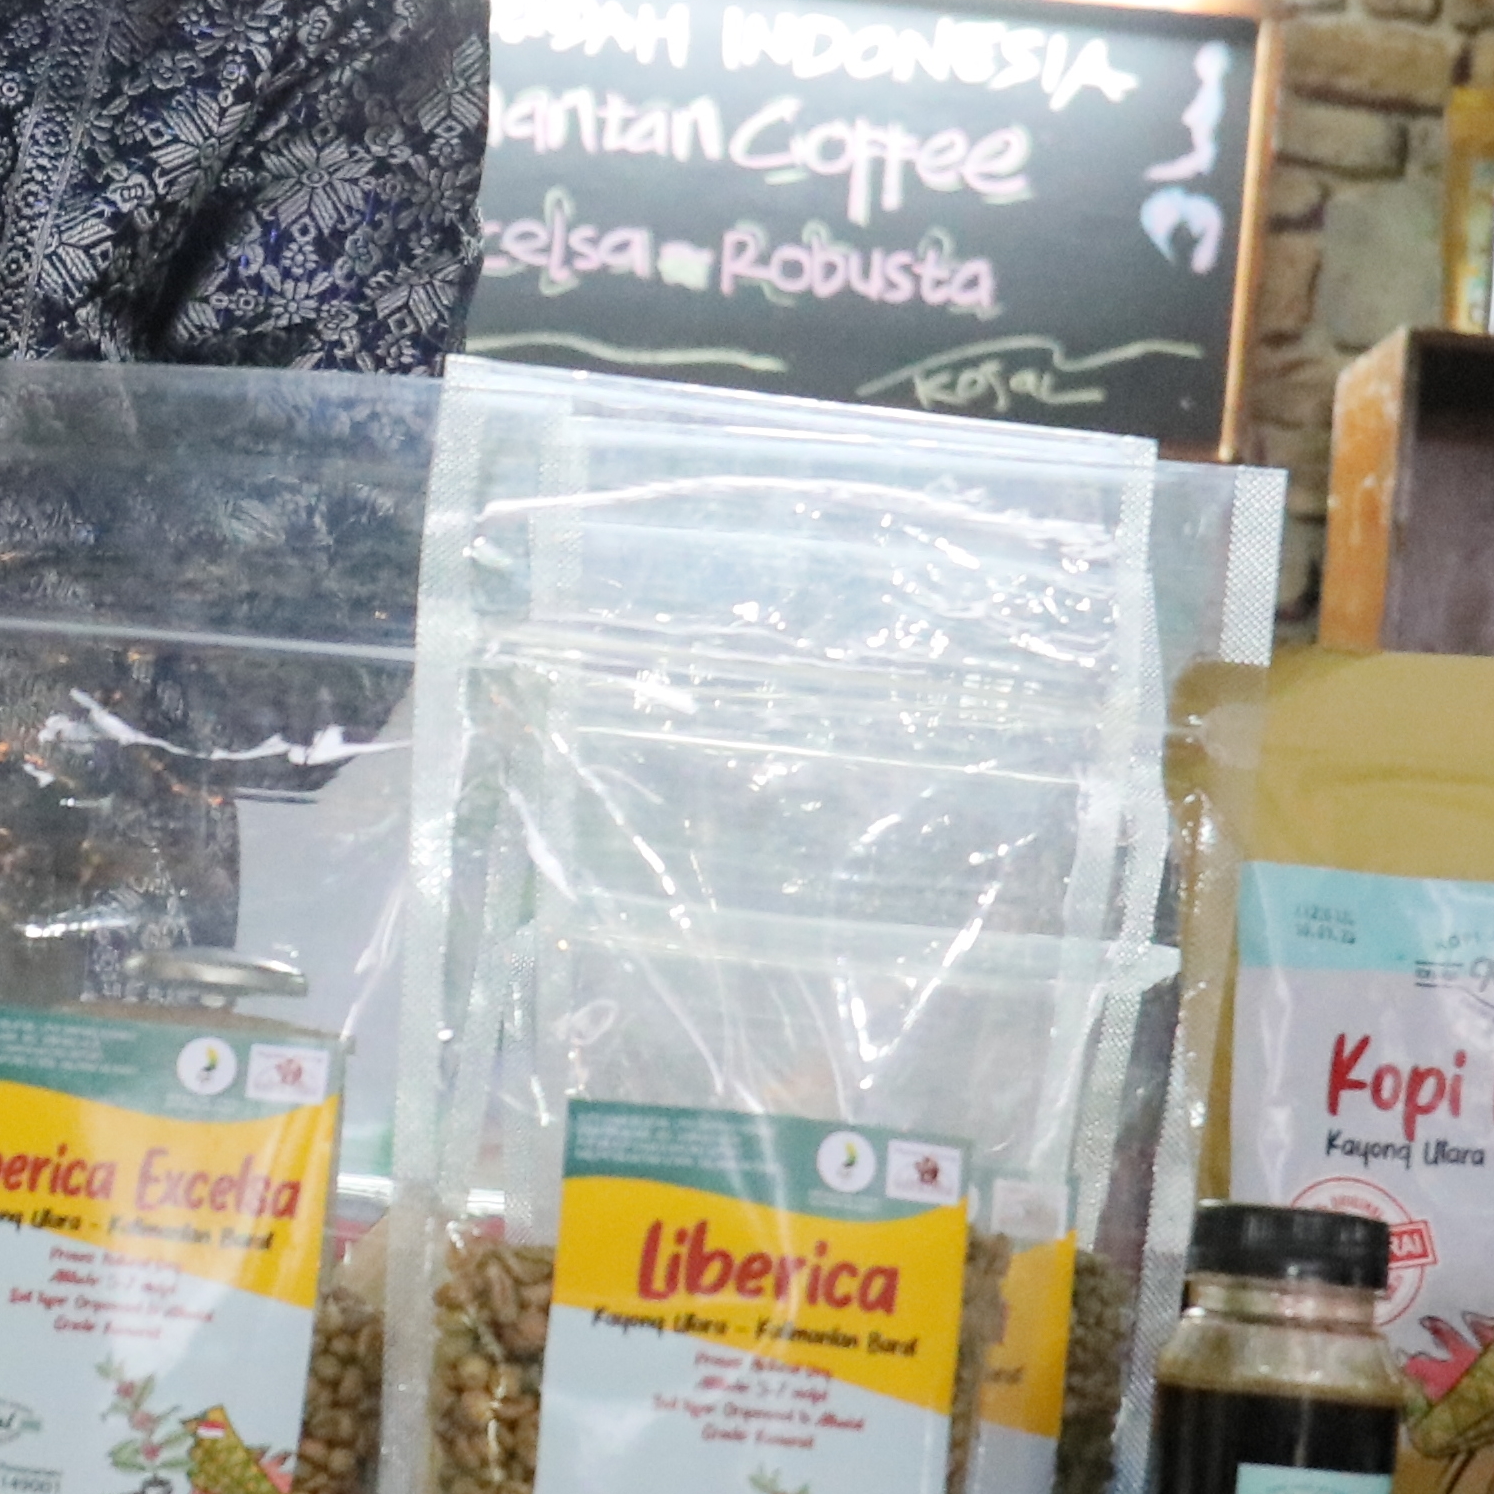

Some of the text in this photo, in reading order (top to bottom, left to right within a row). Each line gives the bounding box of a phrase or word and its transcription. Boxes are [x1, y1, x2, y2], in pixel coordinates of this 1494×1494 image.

[717, 219, 1007, 322] Robusta
[1327, 1031, 1468, 1142] Kopi
[1325, 1128, 1413, 1171] Kayong
[1422, 1137, 1486, 1167] Utara
[638, 1218, 901, 1317] Liberica
